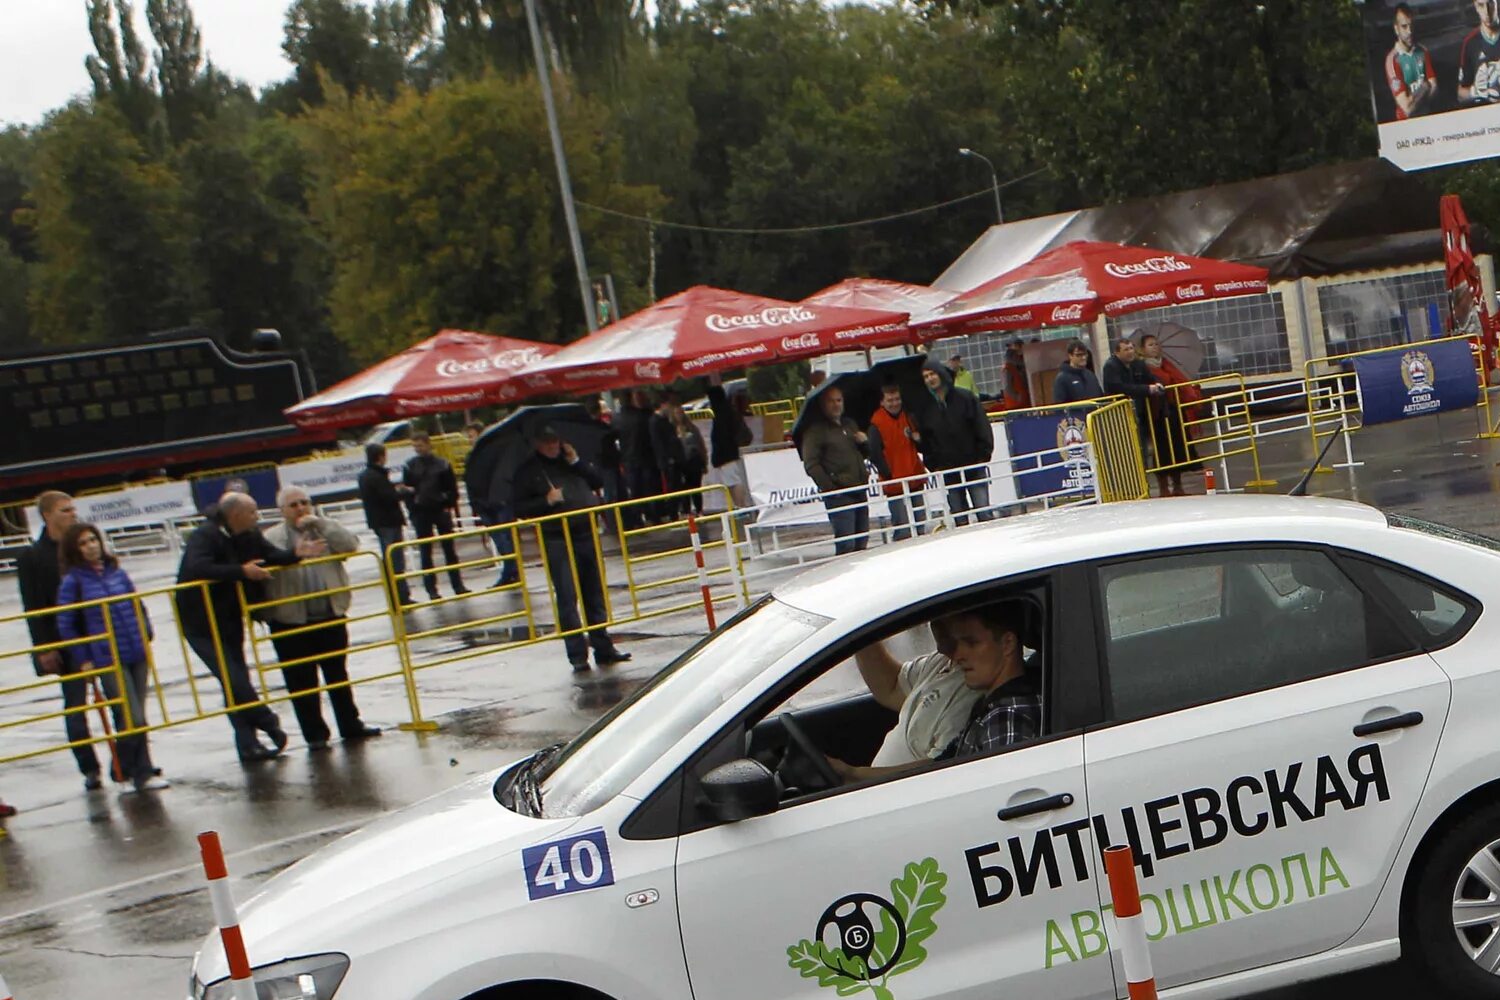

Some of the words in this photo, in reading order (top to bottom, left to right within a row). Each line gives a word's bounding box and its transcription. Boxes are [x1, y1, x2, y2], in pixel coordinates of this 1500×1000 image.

[1396, 139, 1410, 149] ОАО
[1104, 255, 1191, 278] Coca-Cola
[705, 306, 815, 332] Coca-Cola
[781, 333, 820, 350] Coca-Cola
[435, 347, 544, 377] Coca-Cola
[965, 742, 1391, 908] БИТЦЕВСКАЯ
[534, 839, 603, 891] 40
[1045, 847, 1351, 970] АВОШКОЛА
